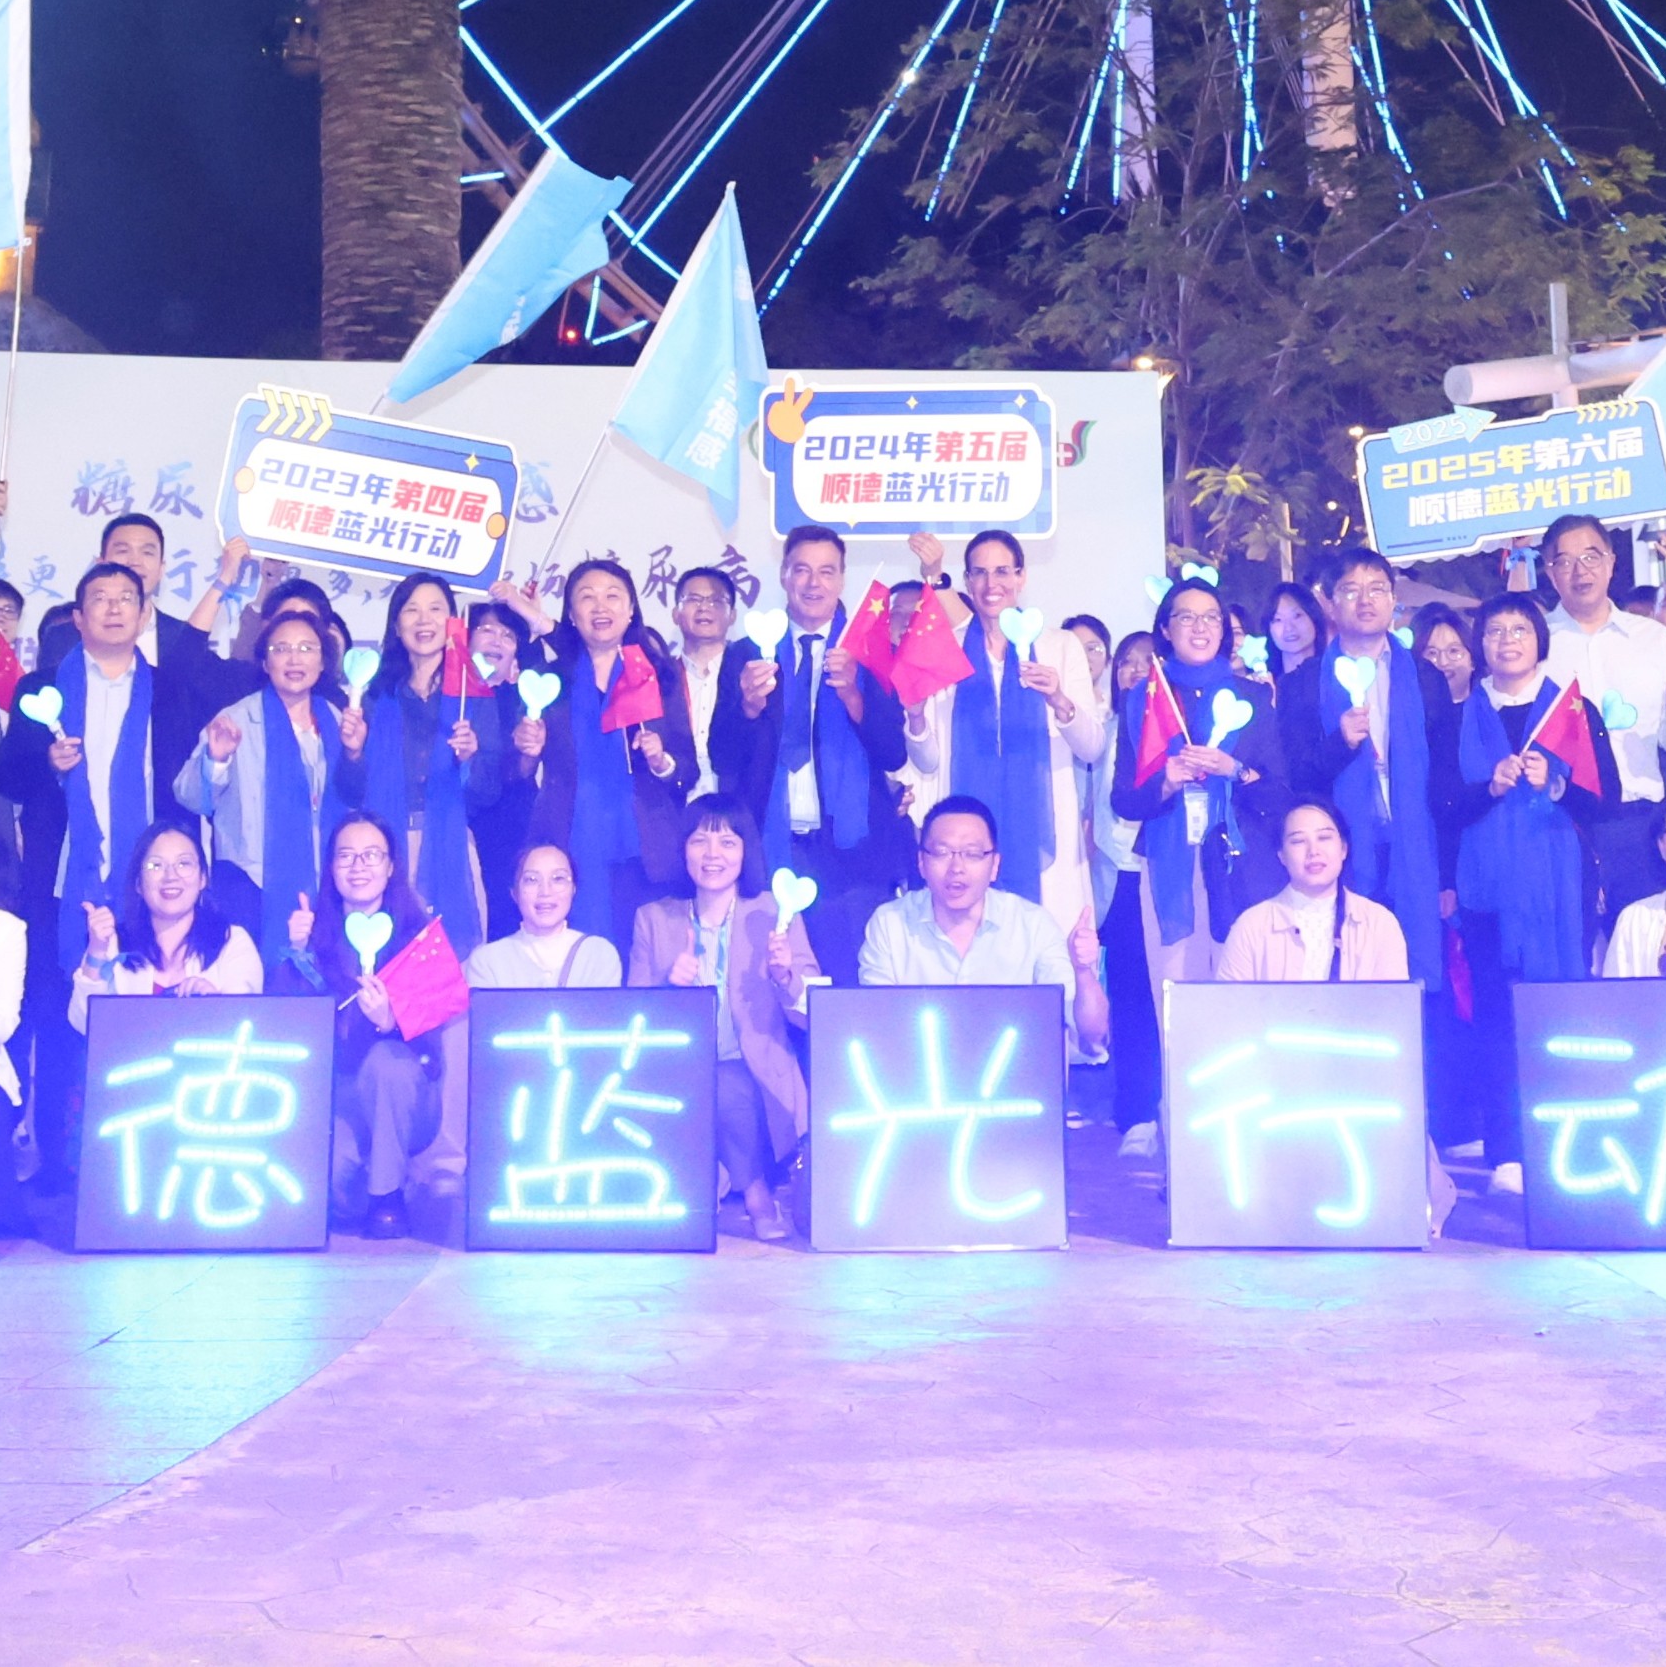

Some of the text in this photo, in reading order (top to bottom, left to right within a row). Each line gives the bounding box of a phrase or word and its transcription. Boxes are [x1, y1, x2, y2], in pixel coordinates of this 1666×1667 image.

[803, 430, 1029, 464] 2024年第五届
[1381, 426, 1646, 490] 2025年第六届
[1400, 414, 1468, 448] 2025
[259, 456, 489, 524] 2023年第四届
[819, 471, 1011, 504] 顺德蓝光行动
[1407, 466, 1632, 527] 顺德蓝光行动
[267, 498, 462, 560] 顺德蓝光行动
[96, 1019, 311, 1228] 德
[488, 1013, 691, 1220] 蓝
[828, 1007, 1043, 1227] 光
[1185, 1029, 1404, 1226] 行
